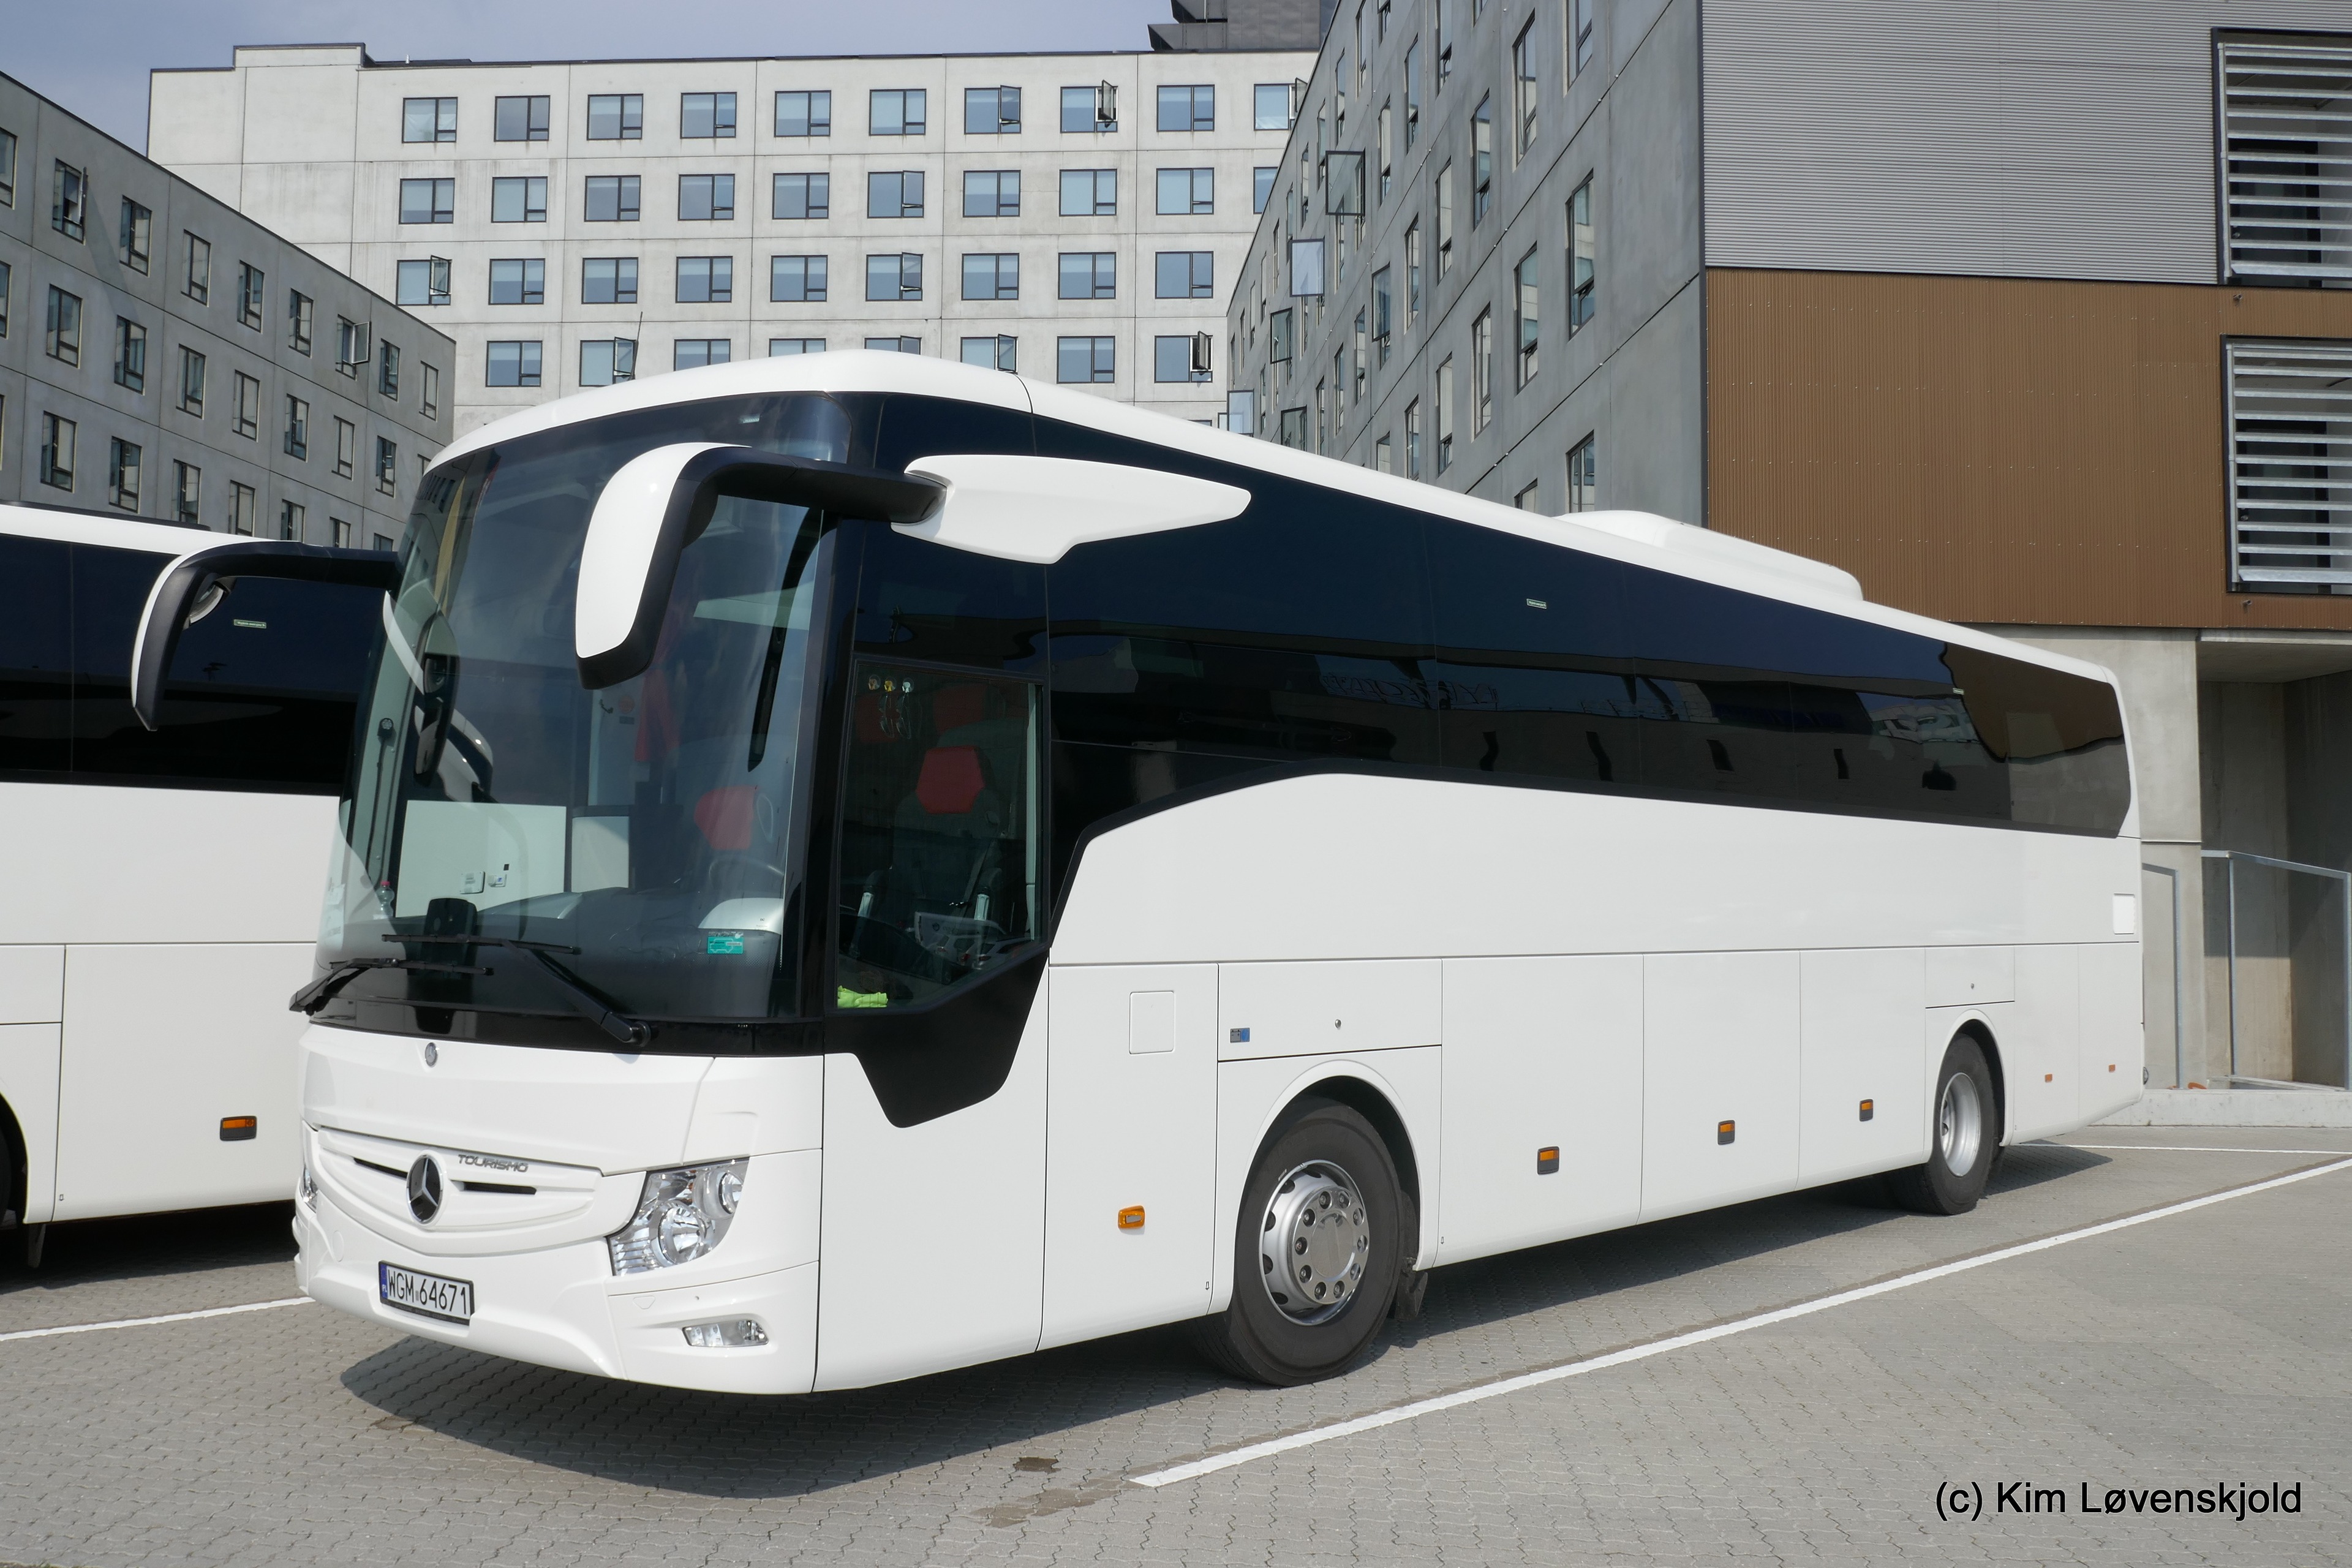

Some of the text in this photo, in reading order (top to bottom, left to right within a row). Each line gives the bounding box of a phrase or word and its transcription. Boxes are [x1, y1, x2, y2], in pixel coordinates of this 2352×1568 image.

[458, 1154, 529, 1172] TOURISMO
[388, 1269, 414, 1303] WGM
[420, 1278, 466, 1314] 64671
